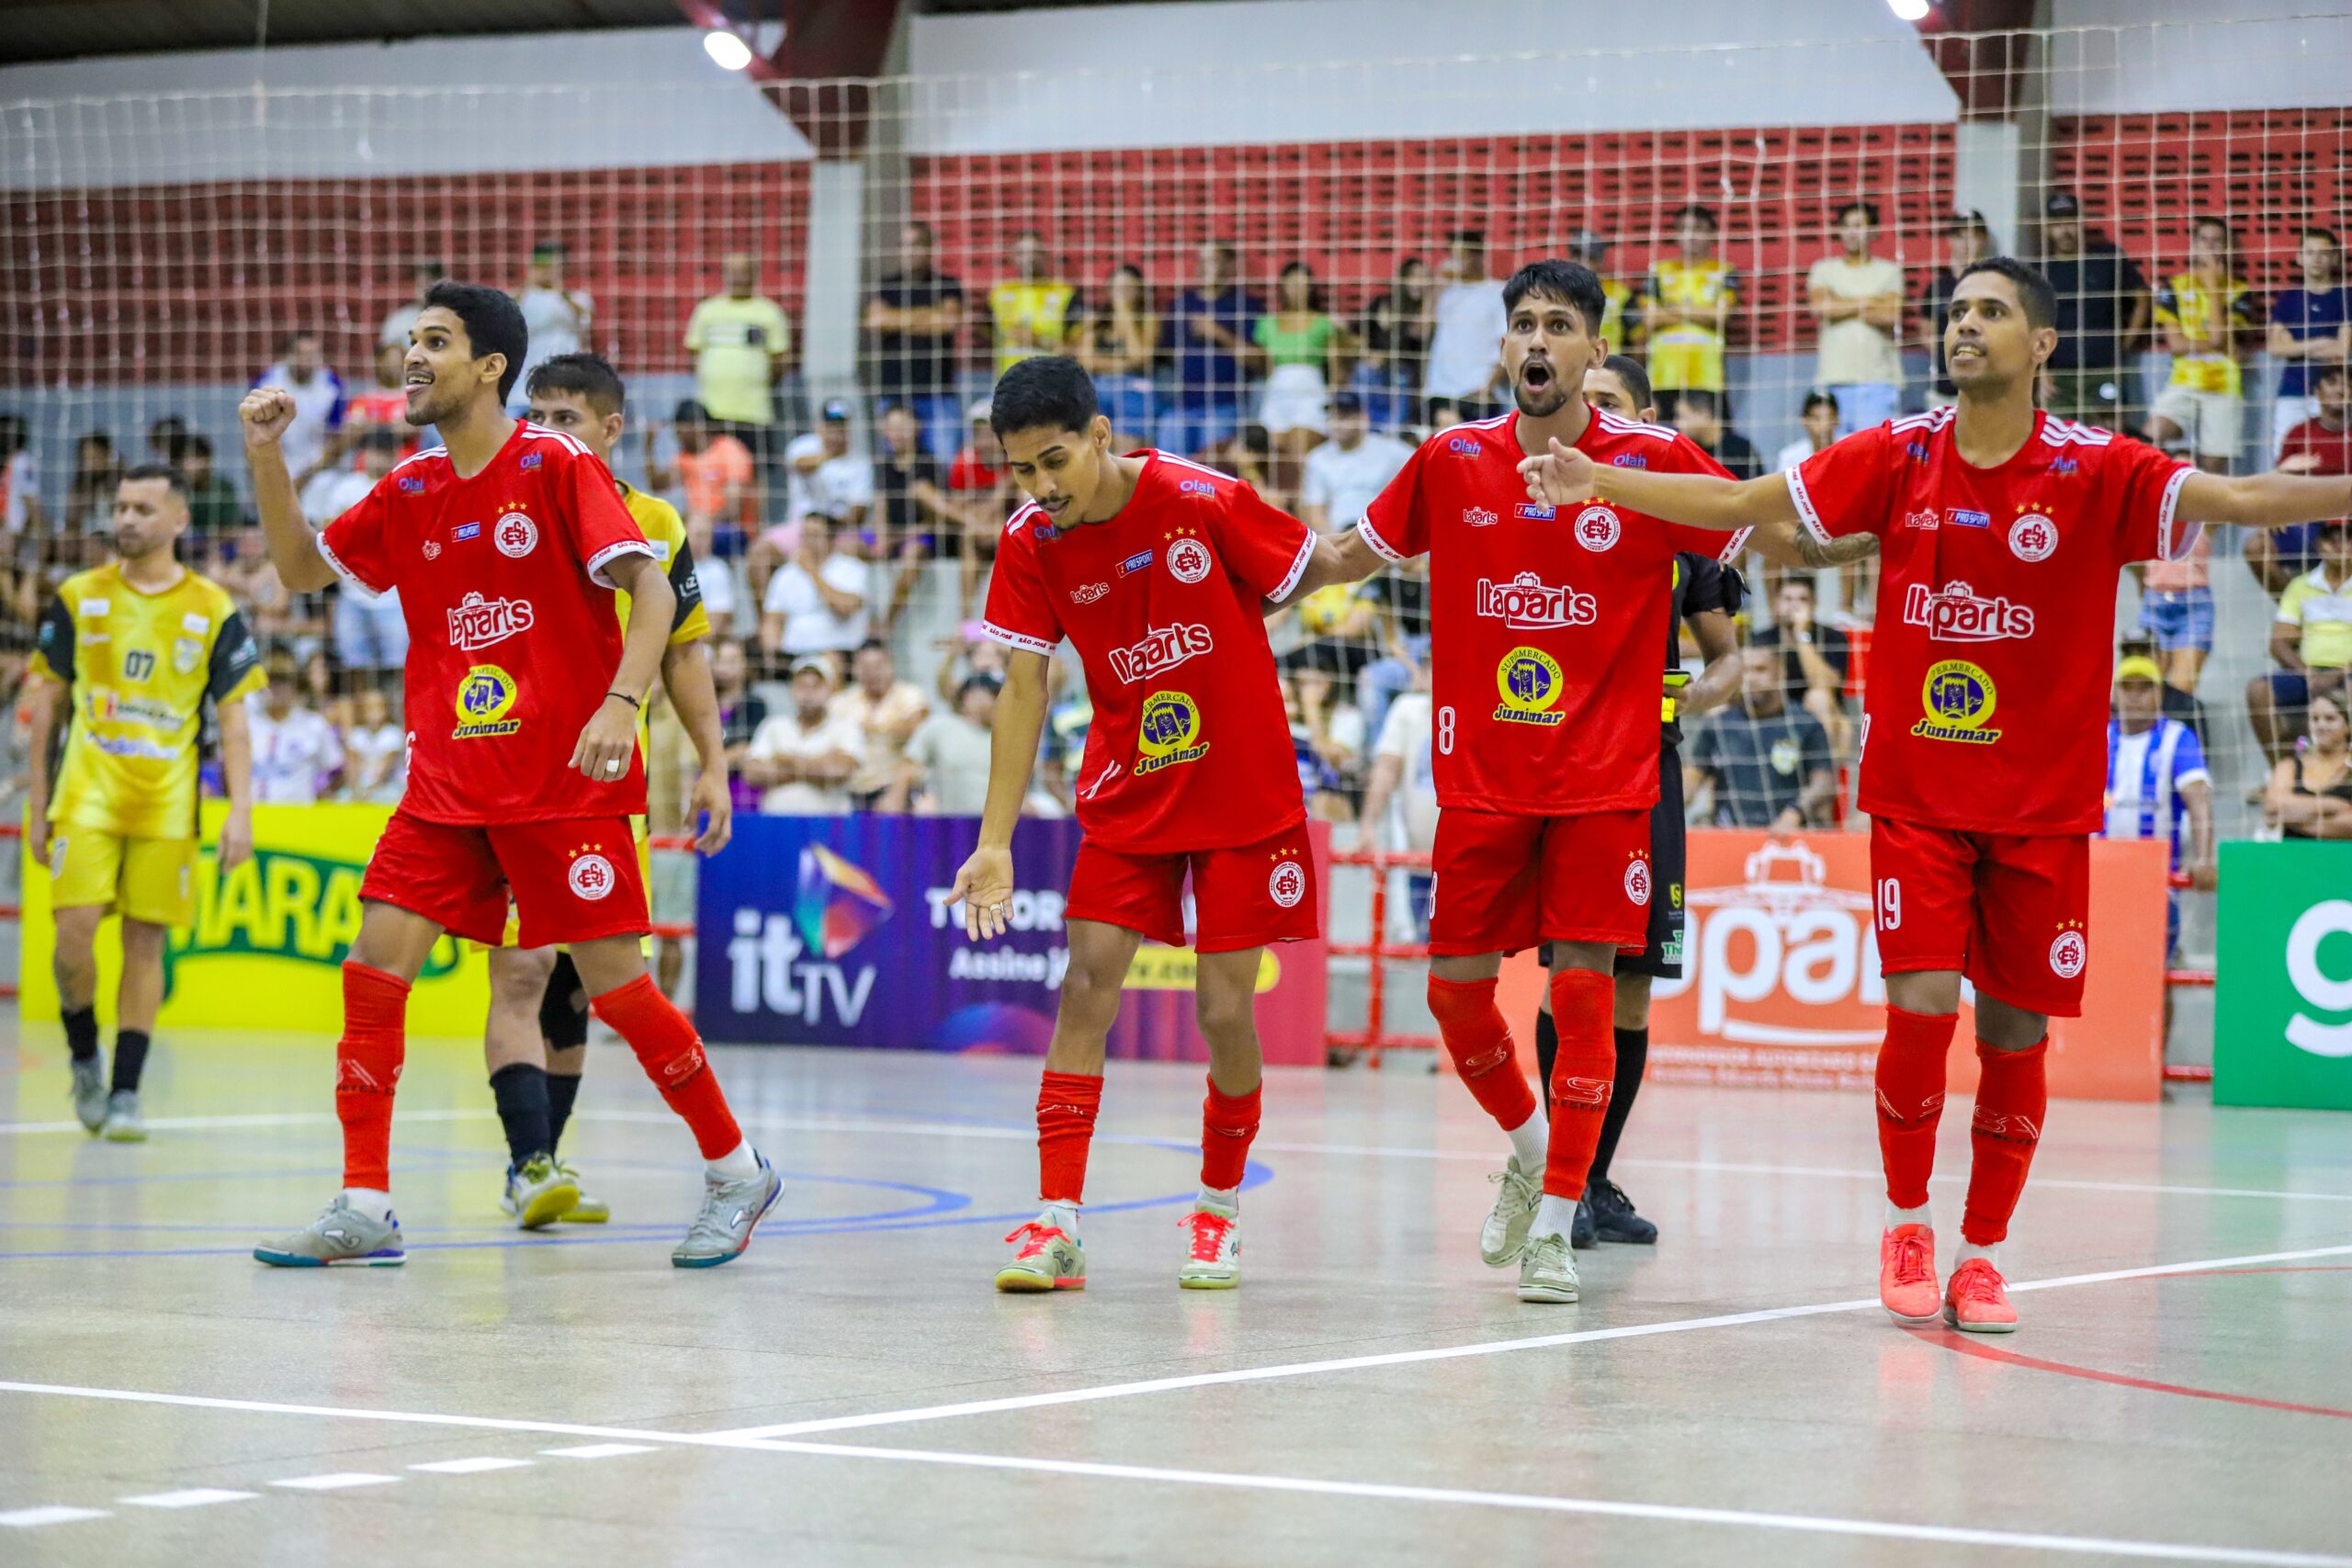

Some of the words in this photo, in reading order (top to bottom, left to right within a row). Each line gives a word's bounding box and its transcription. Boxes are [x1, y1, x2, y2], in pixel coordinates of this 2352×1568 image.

[1449, 438, 1481, 456] Olah
[1613, 453, 1646, 467] Olah
[1180, 479, 1215, 497] Olah
[1476, 578, 1597, 629] Itaparts
[1904, 582, 2035, 641] Itparts
[447, 597, 535, 650] Iparts
[123, 649, 156, 682] 07
[1108, 623, 1213, 684] Itaarts
[1928, 662, 1994, 695] PERMERCADO
[1143, 693, 1196, 716] ERMERCADO
[1494, 705, 1564, 724] Junimar
[1439, 705, 1455, 755] 8
[1913, 720, 2000, 742] Junimar
[1136, 743, 1208, 774] Junimar
[1878, 878, 1901, 931] 19
